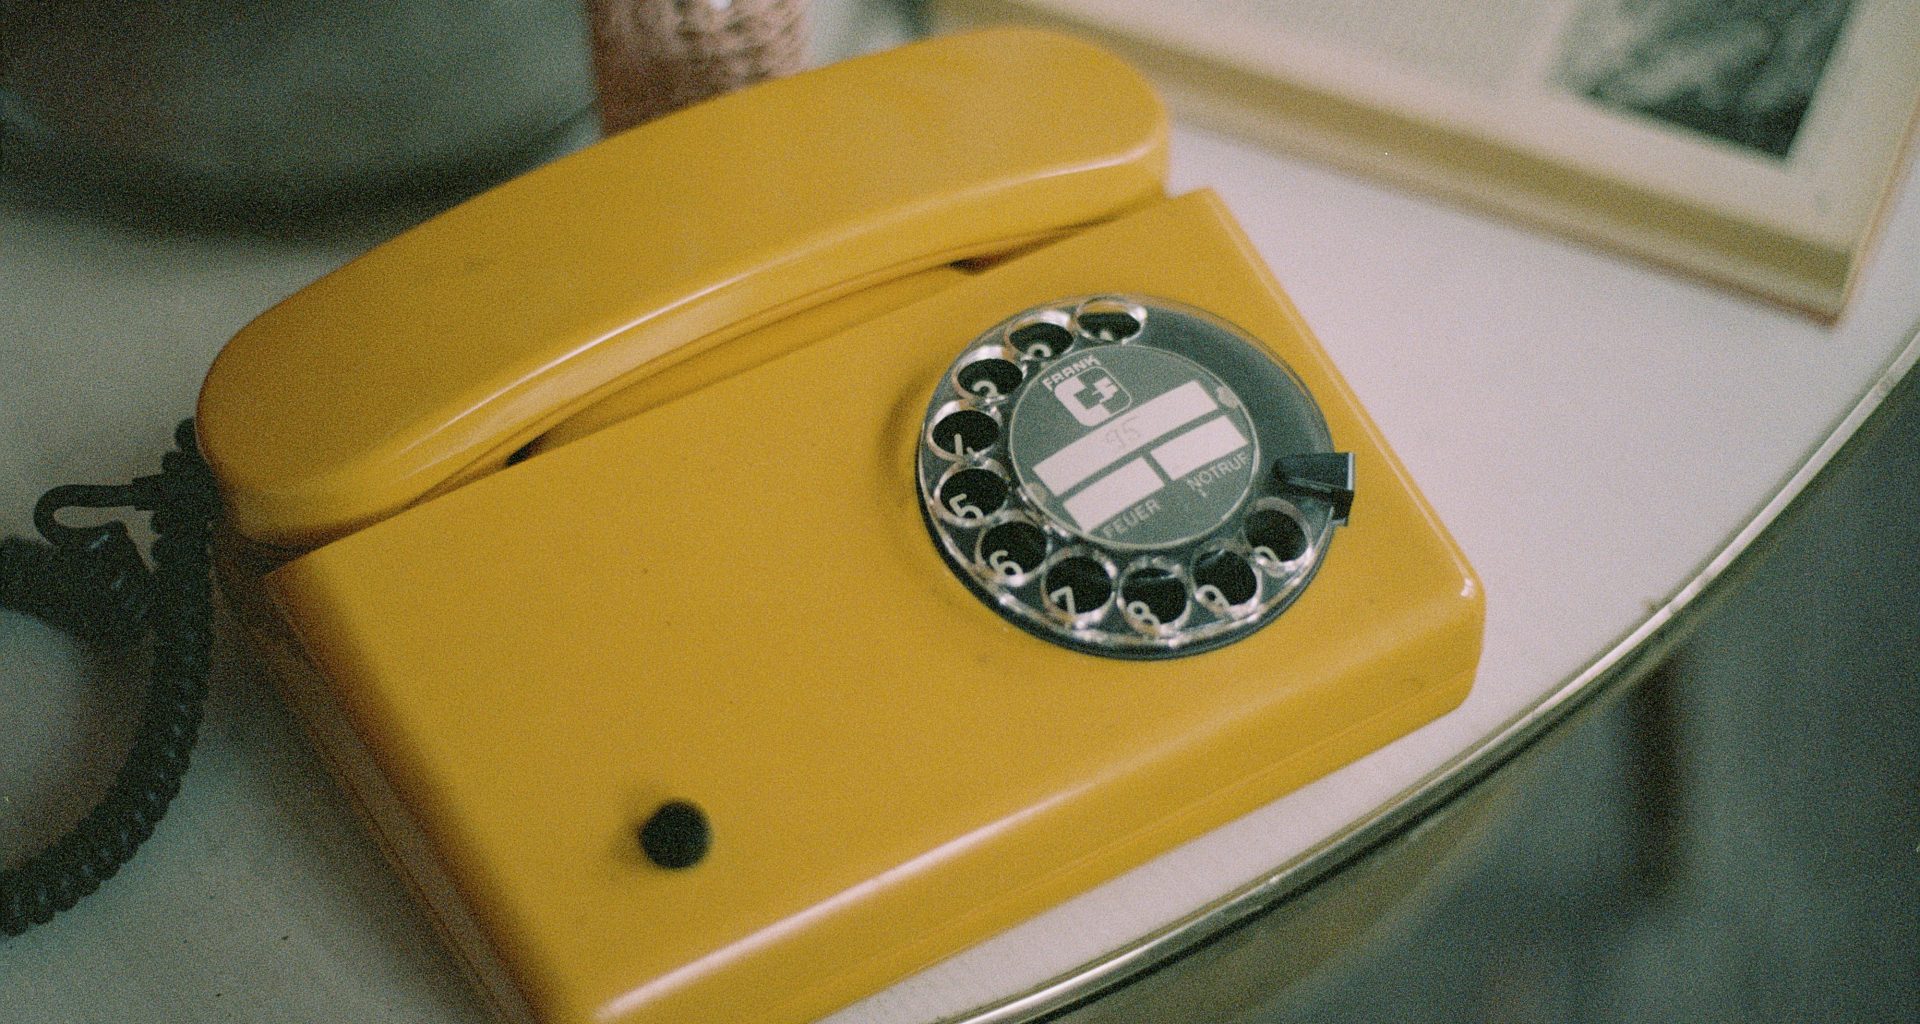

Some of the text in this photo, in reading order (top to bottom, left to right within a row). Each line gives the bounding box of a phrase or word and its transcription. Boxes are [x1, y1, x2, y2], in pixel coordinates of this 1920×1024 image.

[1042, 355, 1101, 391] FRANK
[1187, 450, 1250, 490] NOTRUF
[949, 493, 984, 521] 5
[1102, 498, 1162, 539] FEUER
[989, 550, 1024, 584] 6
[1049, 585, 1077, 619] 7
[1126, 600, 1164, 632] 8
